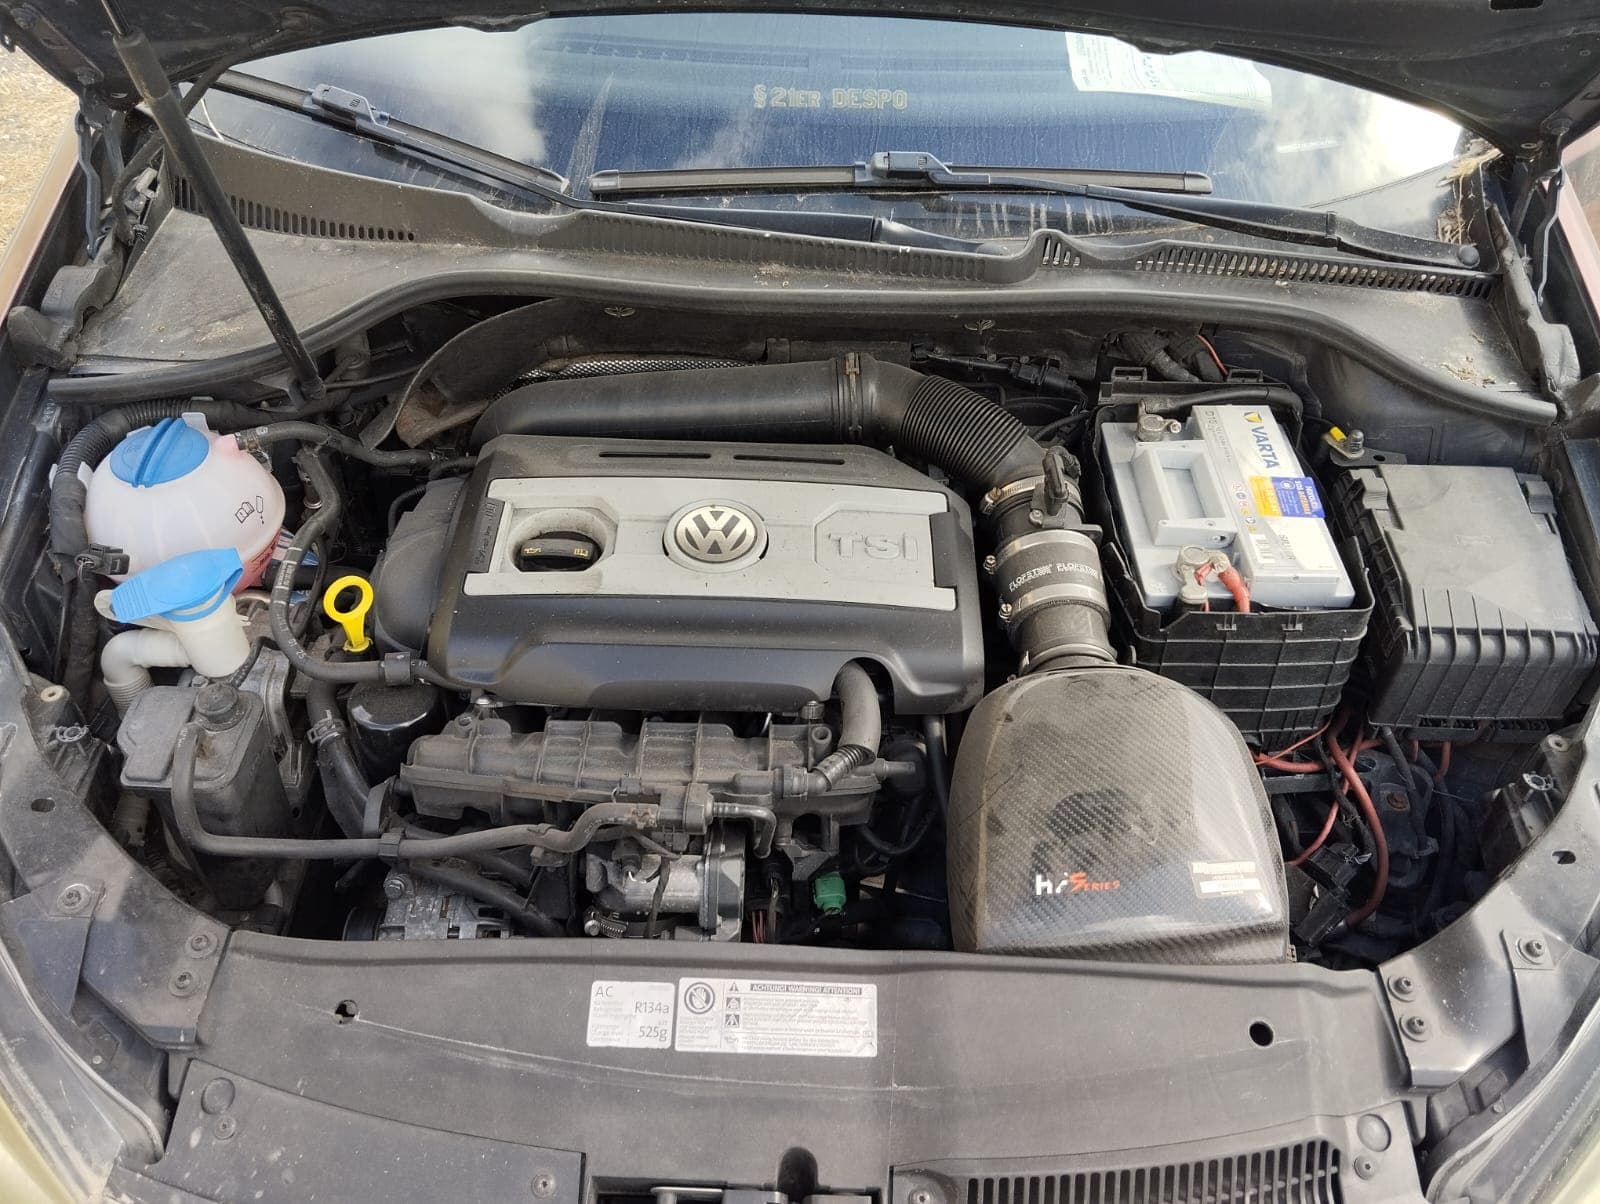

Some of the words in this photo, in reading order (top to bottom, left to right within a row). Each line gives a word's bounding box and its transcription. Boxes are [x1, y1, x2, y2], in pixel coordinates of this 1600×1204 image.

[832, 88, 908, 109] DESPO
[1251, 425, 1280, 469] VARTA
[827, 532, 919, 561] TSI
[595, 985, 614, 998] AC
[634, 1001, 670, 1014] R134a
[639, 1024, 668, 1041] 525g
